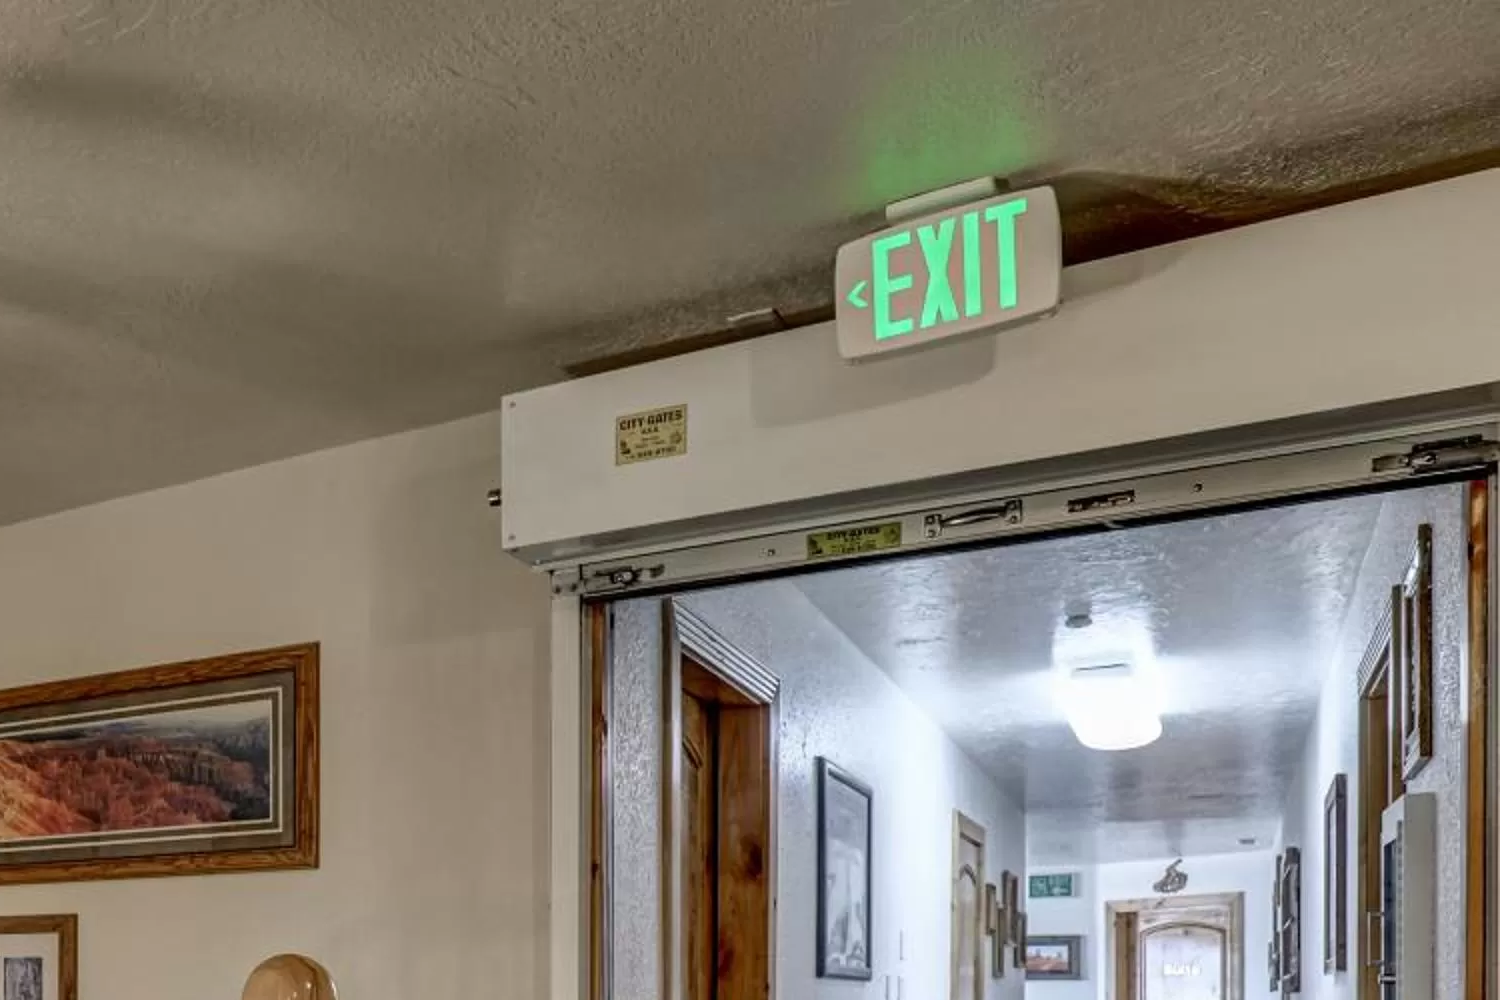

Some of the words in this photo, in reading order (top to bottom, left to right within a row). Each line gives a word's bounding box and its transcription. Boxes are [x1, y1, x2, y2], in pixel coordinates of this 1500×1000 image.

[873, 198, 1028, 341] EXIT
[619, 417, 645, 431] CITY
[647, 409, 683, 425] GATES
